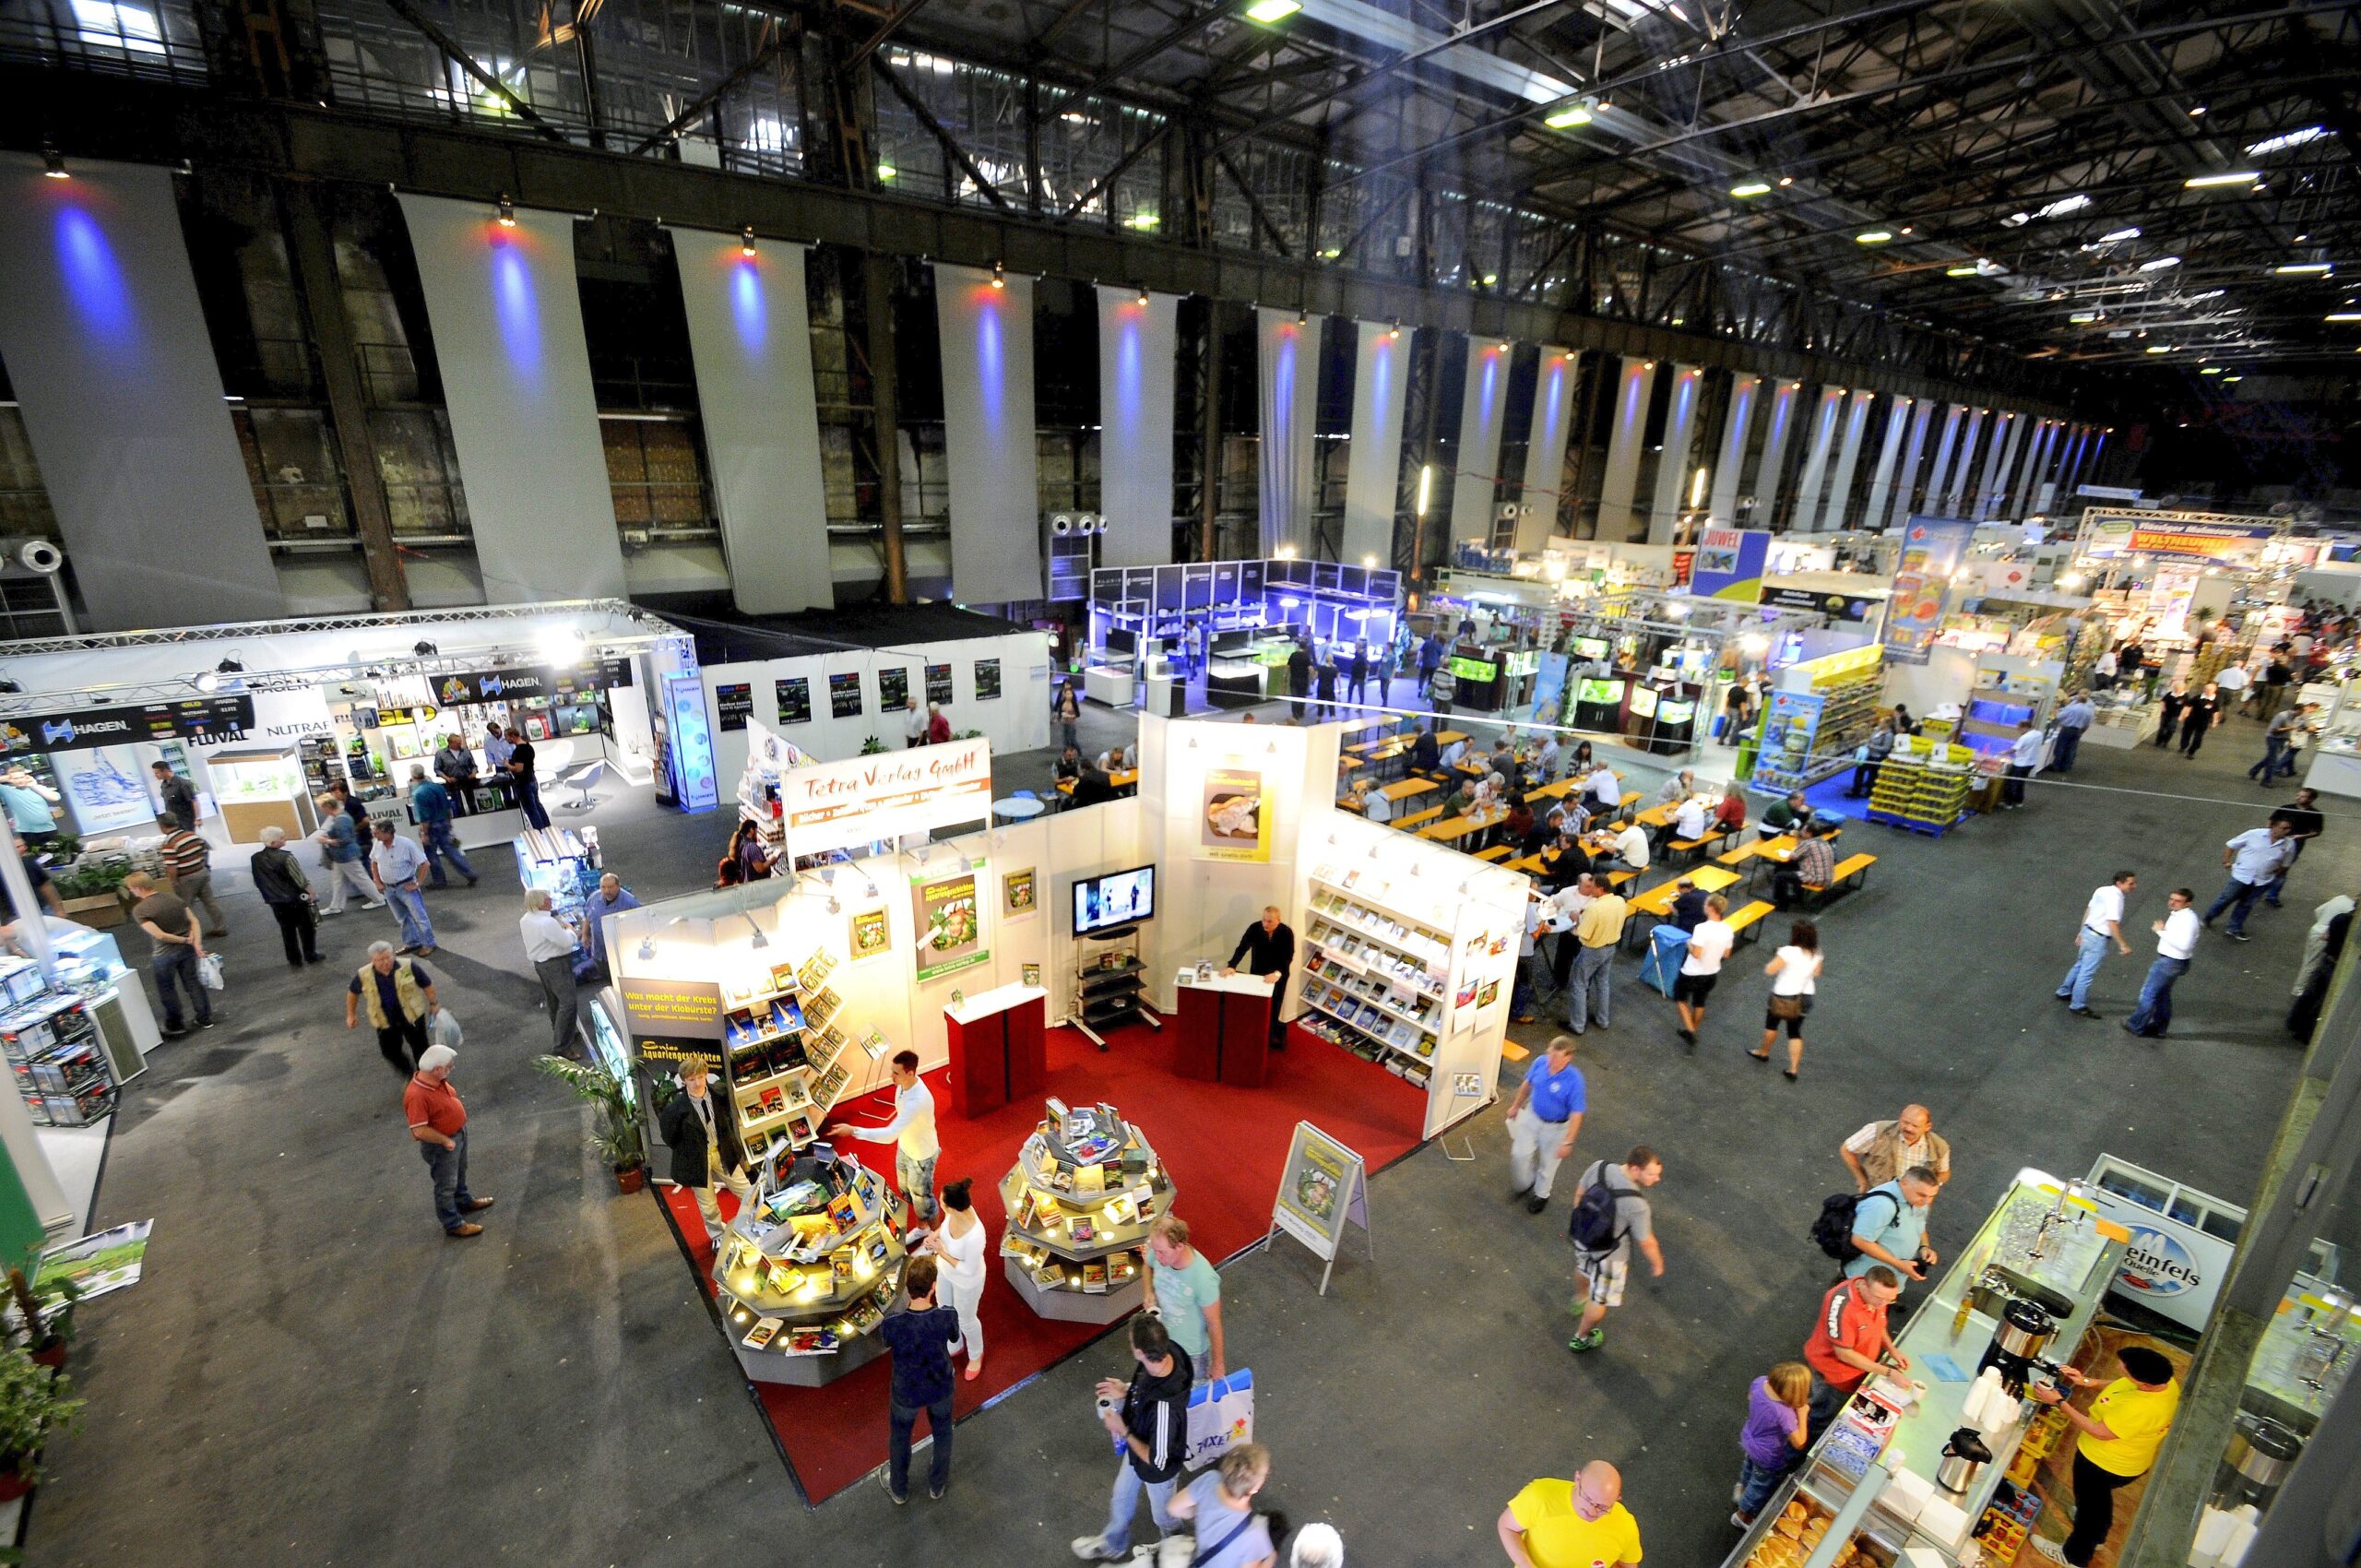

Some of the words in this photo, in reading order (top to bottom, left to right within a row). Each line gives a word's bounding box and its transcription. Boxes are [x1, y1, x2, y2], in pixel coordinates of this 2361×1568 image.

[1703, 529, 1739, 548] JUWEL
[2137, 533, 2231, 549] WELTNEUHEIT
[502, 676, 540, 689] HAGEN
[73, 720, 127, 736] HAGEN
[188, 730, 249, 748] FLUVAL
[804, 777, 859, 801] Tetra
[864, 762, 922, 788] Verlag
[930, 751, 976, 780] GmbH
[369, 808, 403, 821] LUVAL
[624, 992, 644, 1001] Was
[646, 993, 674, 1003] macht
[676, 994, 690, 1003] der
[693, 995, 717, 1004] Krebs
[628, 1003, 652, 1011] unter
[655, 1004, 670, 1012] der
[671, 1004, 718, 1015] Klobürste?
[643, 1050, 721, 1063] Aquariengeschichten
[2124, 1257, 2160, 1278] Quelle
[2127, 1246, 2201, 1287] einfels
